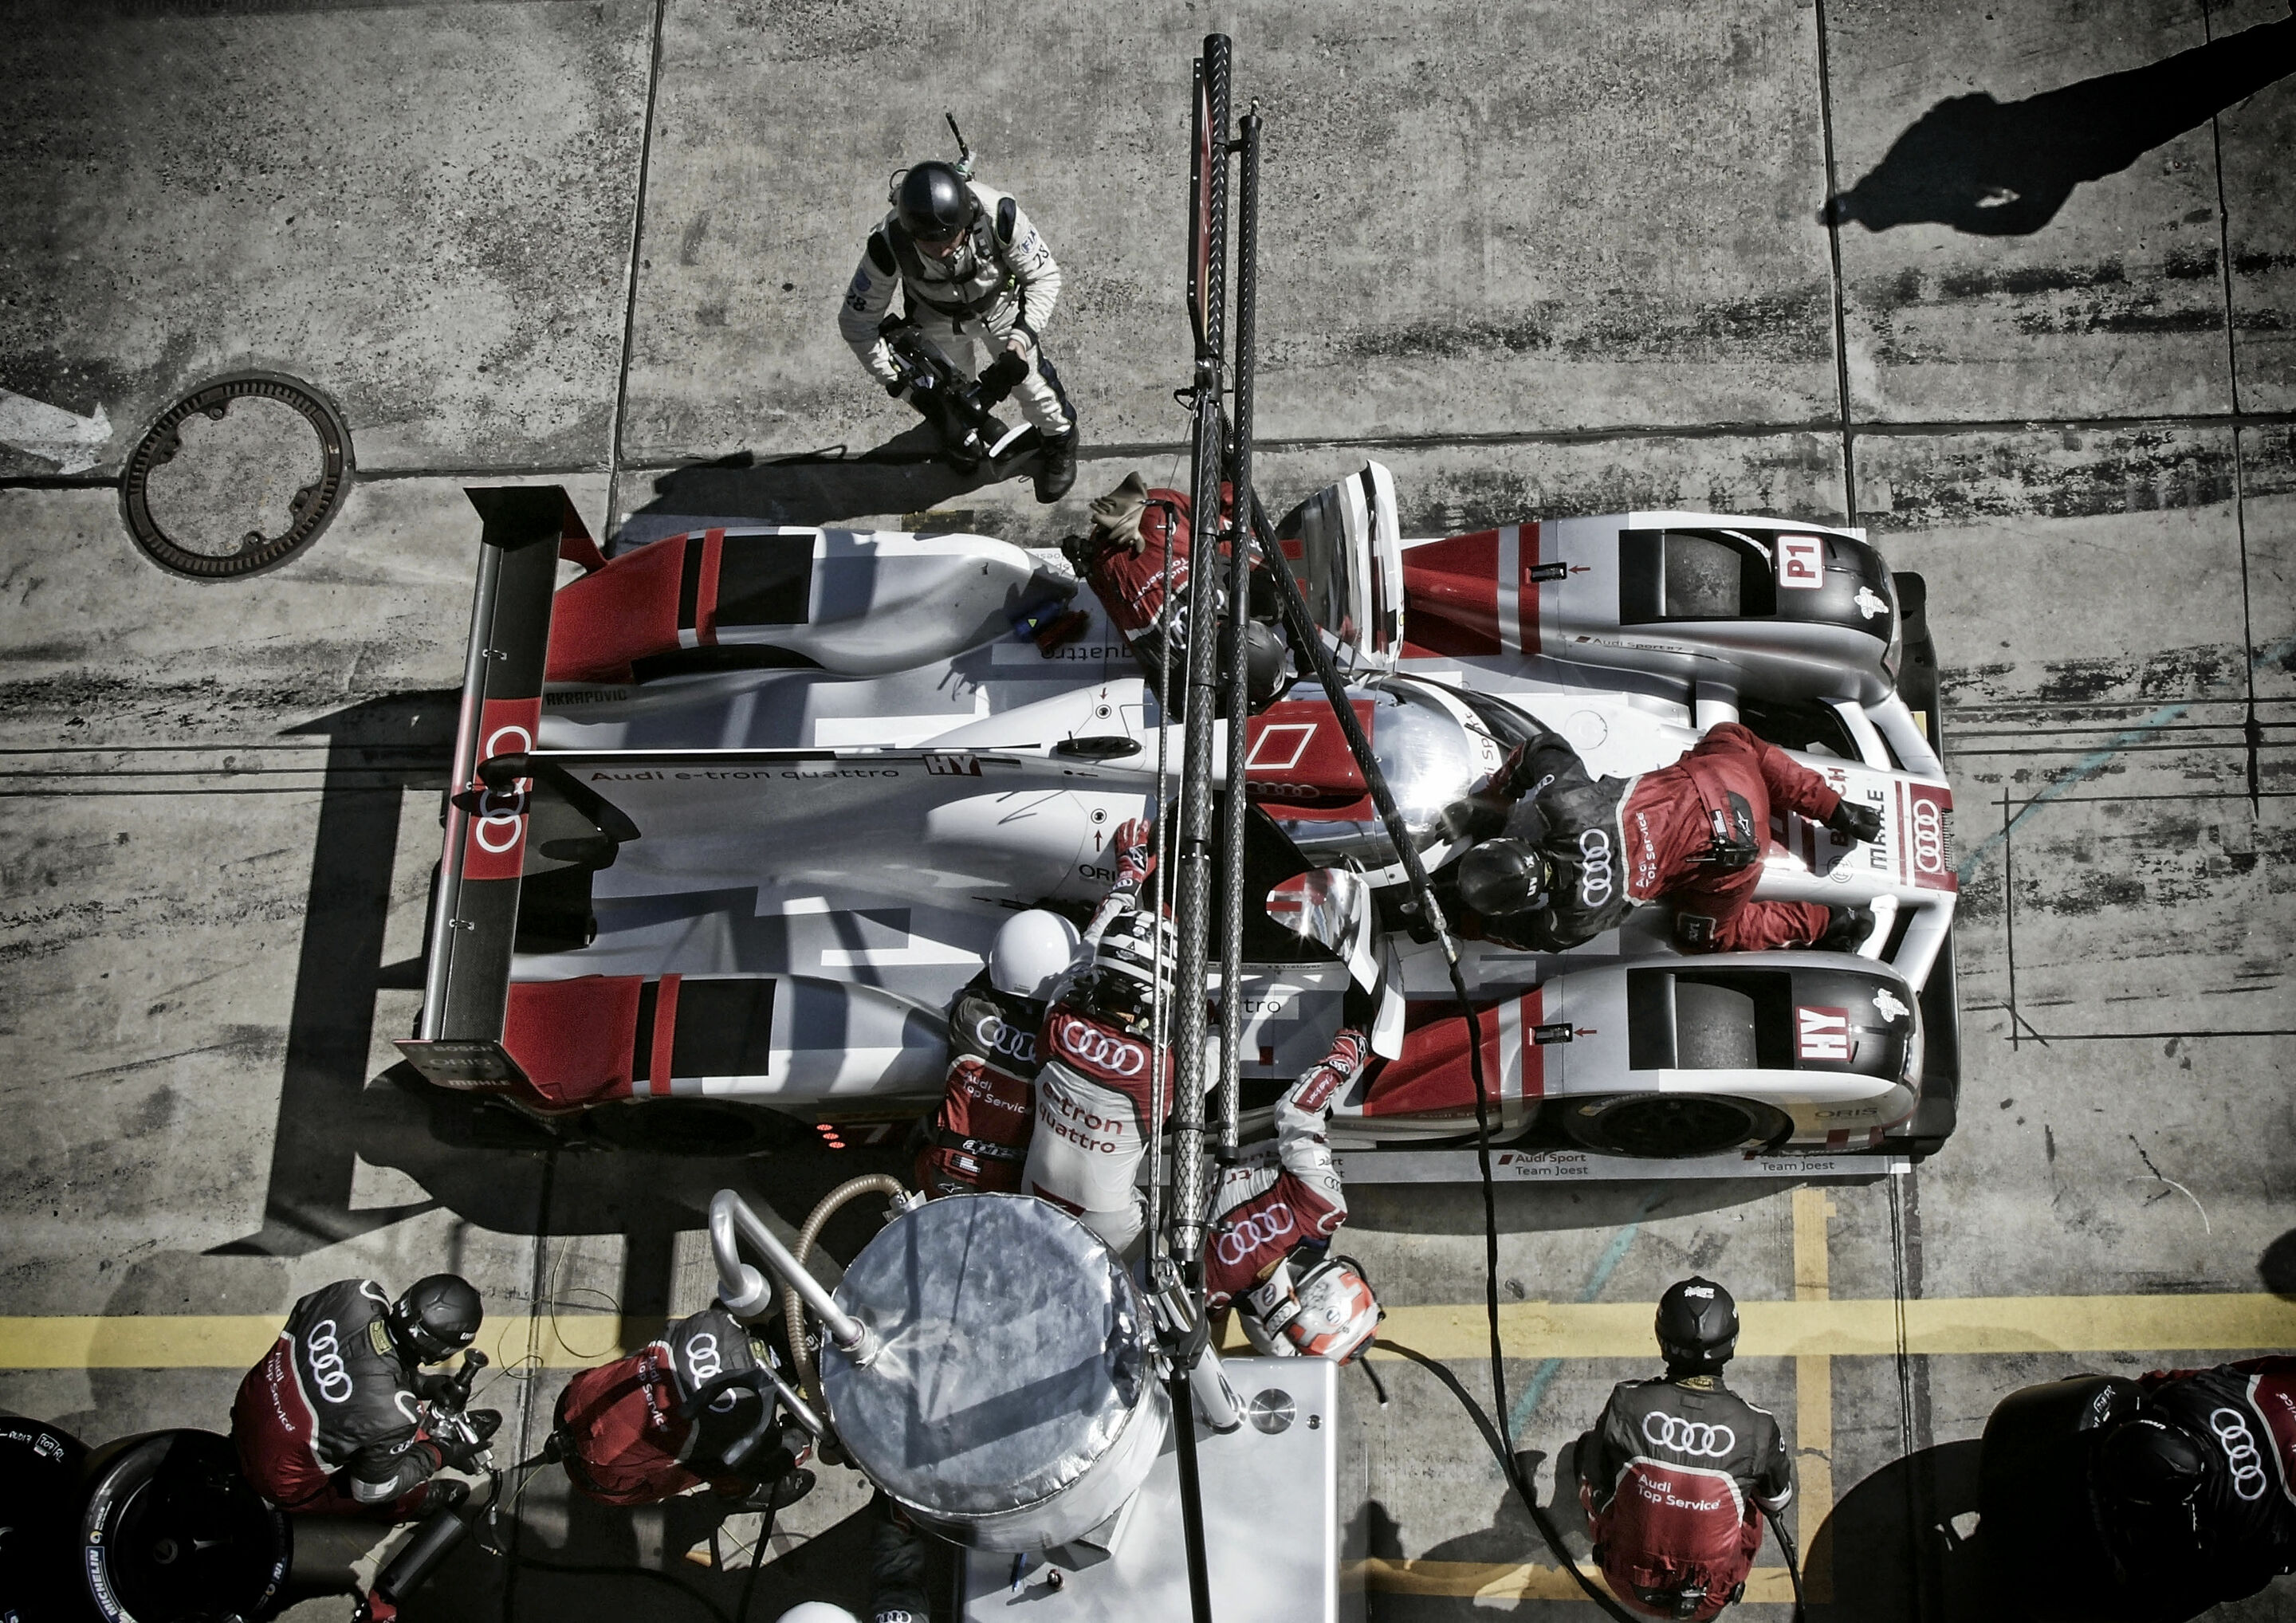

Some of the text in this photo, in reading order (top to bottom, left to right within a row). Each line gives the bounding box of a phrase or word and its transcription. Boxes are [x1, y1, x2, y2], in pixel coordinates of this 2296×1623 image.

[1022, 230, 1036, 253] FIA
[1786, 545, 1816, 579] P1
[591, 768, 899, 781] Audi e-tron quattro
[926, 755, 973, 776] HY
[1637, 812, 1656, 860] Service
[1079, 864, 1115, 882] ORI
[1799, 1008, 1848, 1059] HY
[963, 1081, 981, 1098] Top
[965, 1071, 993, 1091] Audi
[1043, 1082, 1123, 1135] e-tron
[1815, 1107, 1877, 1117] ORIS
[1040, 1102, 1116, 1153] quattro
[1516, 1153, 1586, 1164] Audi Sport
[1760, 1161, 1835, 1172] Team Joest
[1516, 1166, 1588, 1177] Team Joest
[275, 1352, 284, 1382] Audi
[639, 1361, 647, 1381] Top
[650, 1356, 662, 1383] Audi
[265, 1359, 296, 1432] Top Service
[41, 1436, 54, 1450] 707
[1638, 1474, 1671, 1493] Audi
[1637, 1483, 1720, 1511] Top Service
[90, 1550, 118, 1617] MICHELIN
